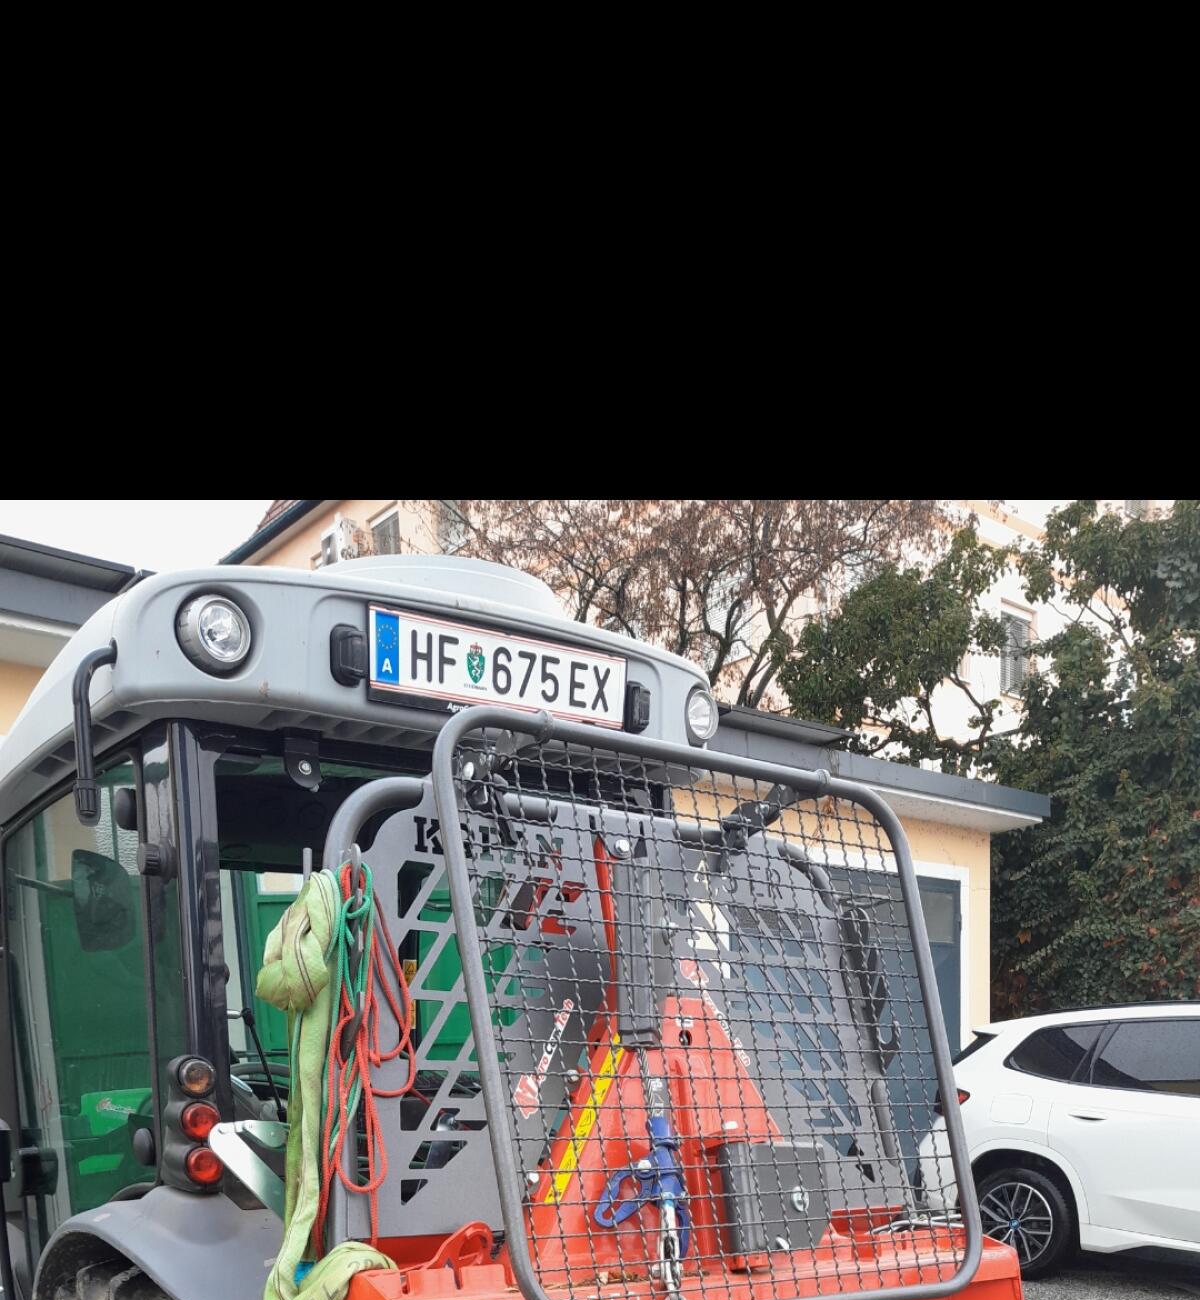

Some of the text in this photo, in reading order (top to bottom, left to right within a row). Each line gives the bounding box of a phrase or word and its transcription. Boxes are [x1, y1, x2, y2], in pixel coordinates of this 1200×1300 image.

[381, 657, 393, 675] A
[410, 628, 611, 713] HF 675 EX
